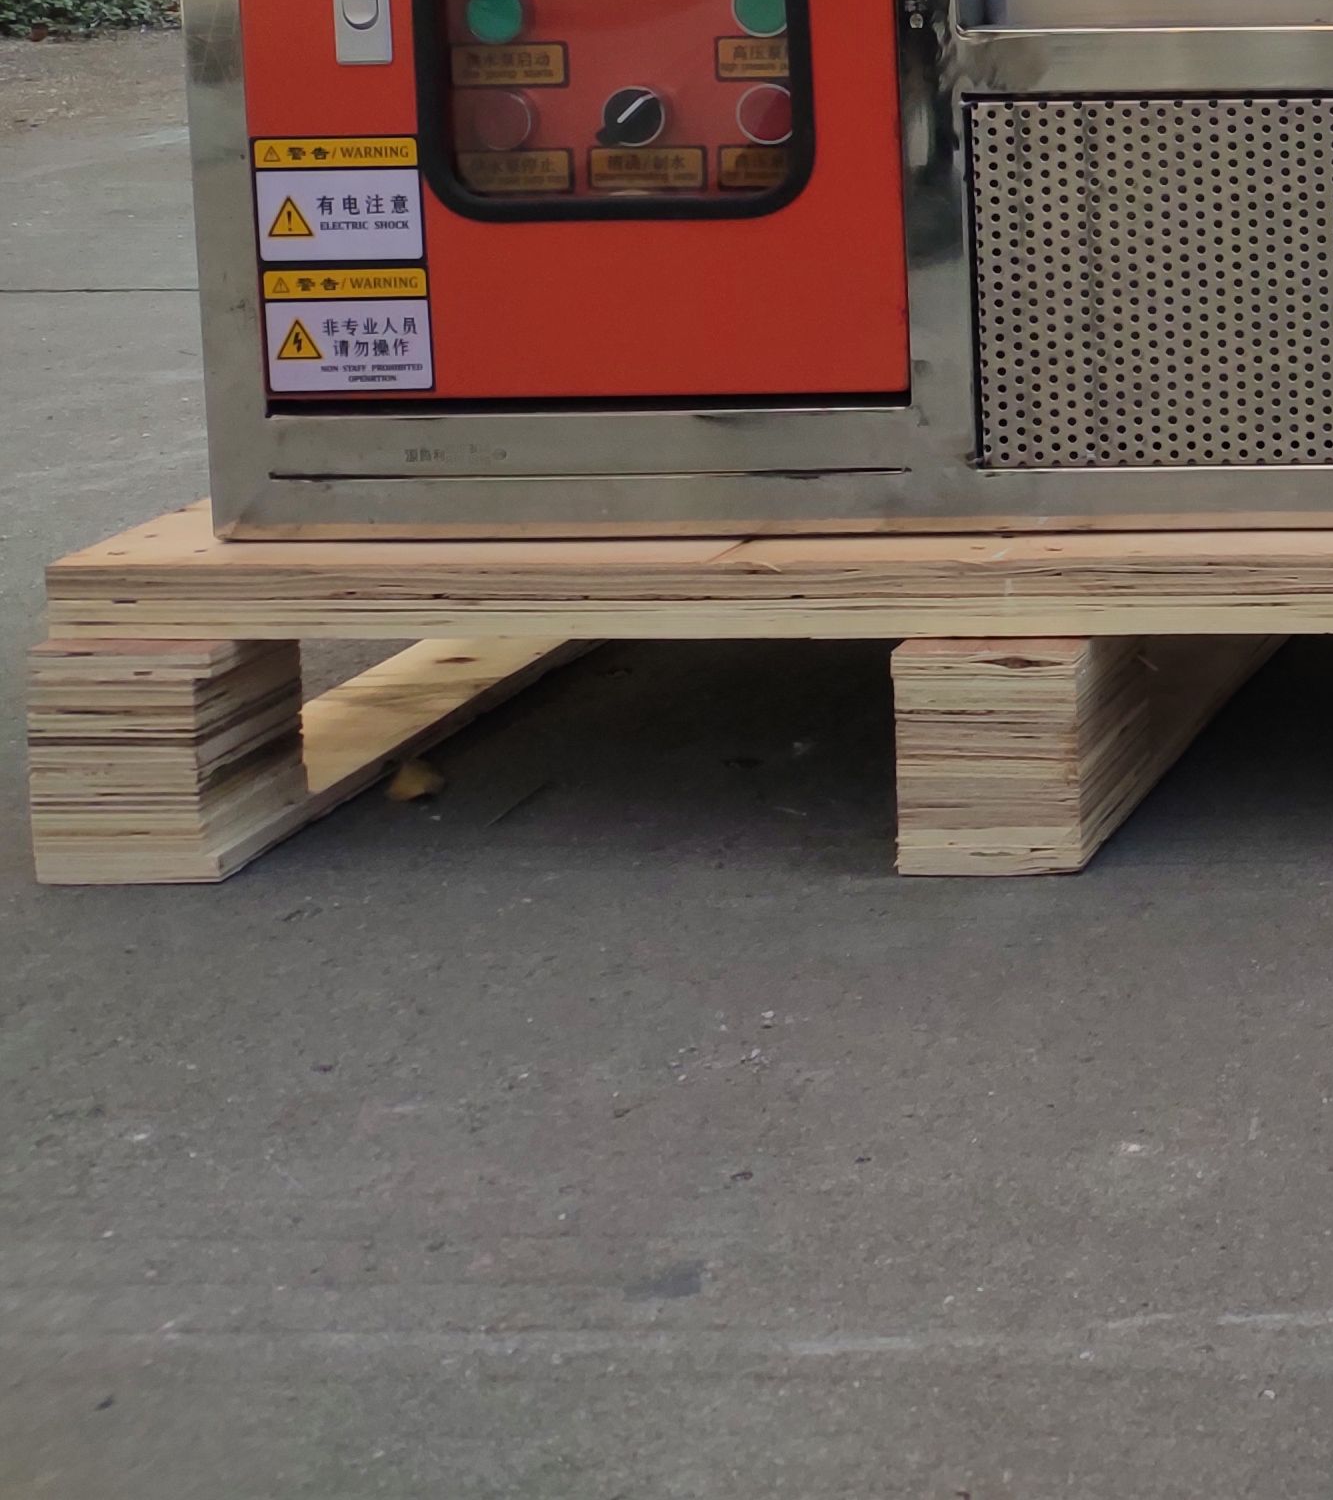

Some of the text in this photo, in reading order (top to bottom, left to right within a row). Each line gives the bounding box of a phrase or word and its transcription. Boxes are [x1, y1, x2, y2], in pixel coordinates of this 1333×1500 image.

[340, 146, 409, 159] WARNING
[316, 194, 409, 216] 有电注意
[320, 220, 410, 231] ELECTRIC SHOCK
[349, 276, 418, 289] WARNING
[322, 317, 417, 336] 非专业人员
[333, 338, 410, 357] 请勿操作
